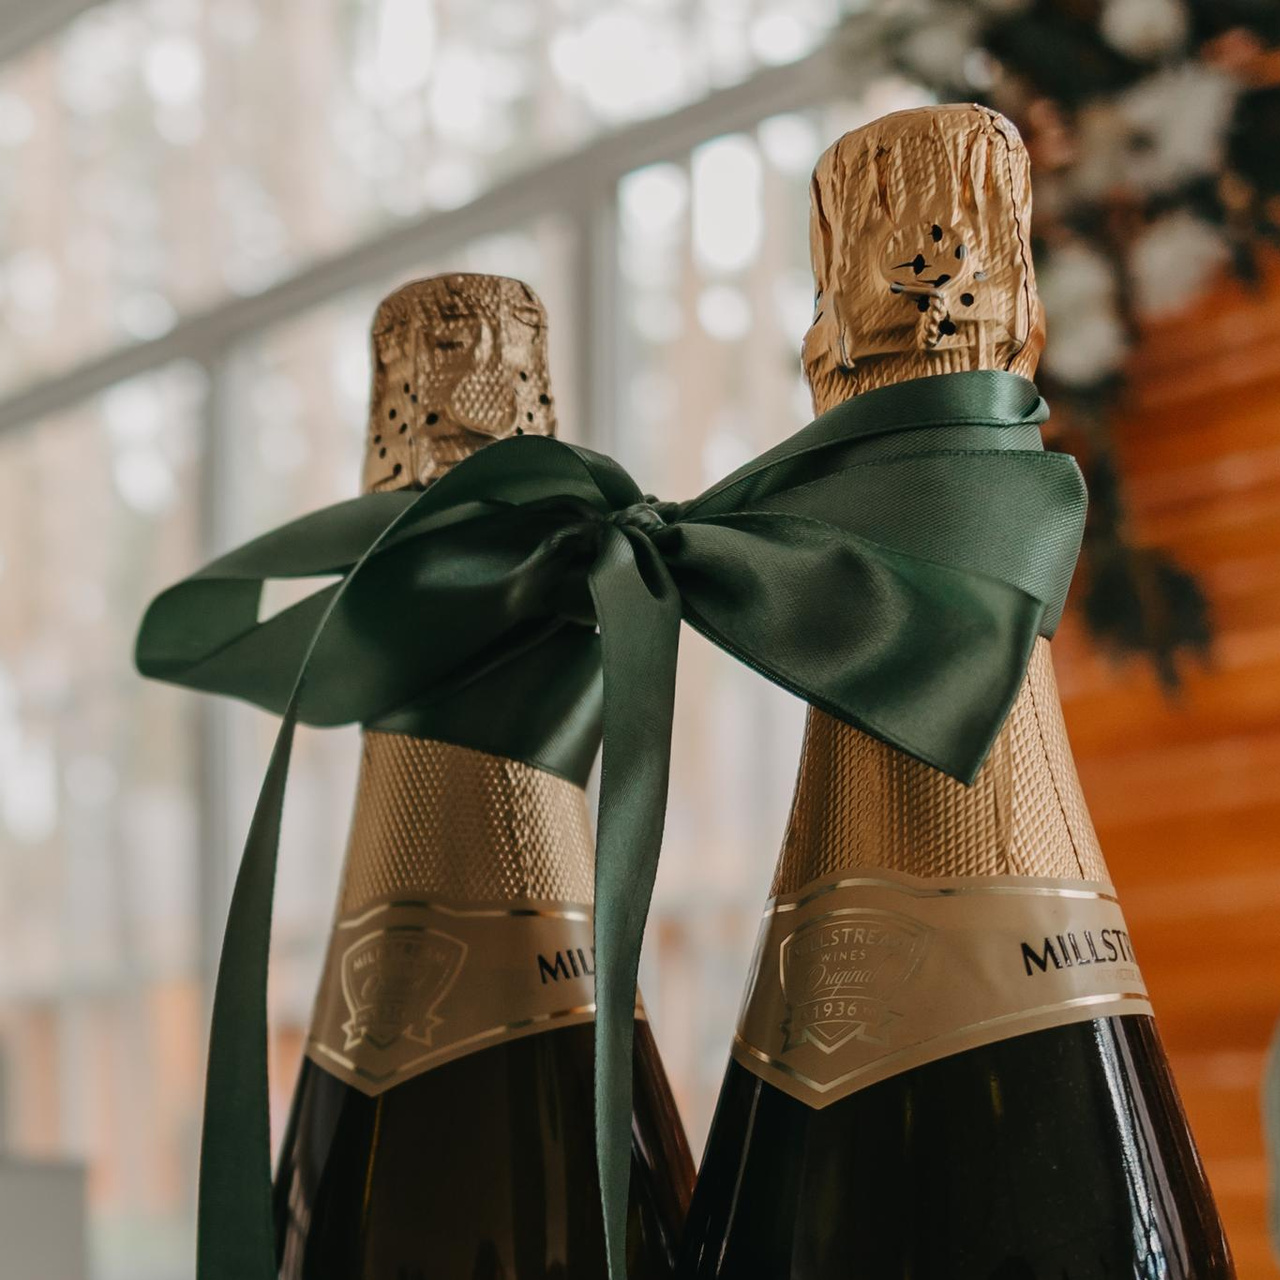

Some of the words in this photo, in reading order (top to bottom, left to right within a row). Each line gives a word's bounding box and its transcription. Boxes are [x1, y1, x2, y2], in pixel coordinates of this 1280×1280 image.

[821, 949, 867, 962] WINES
[537, 947, 596, 984] MIL
[813, 1001, 857, 1019] 1936
